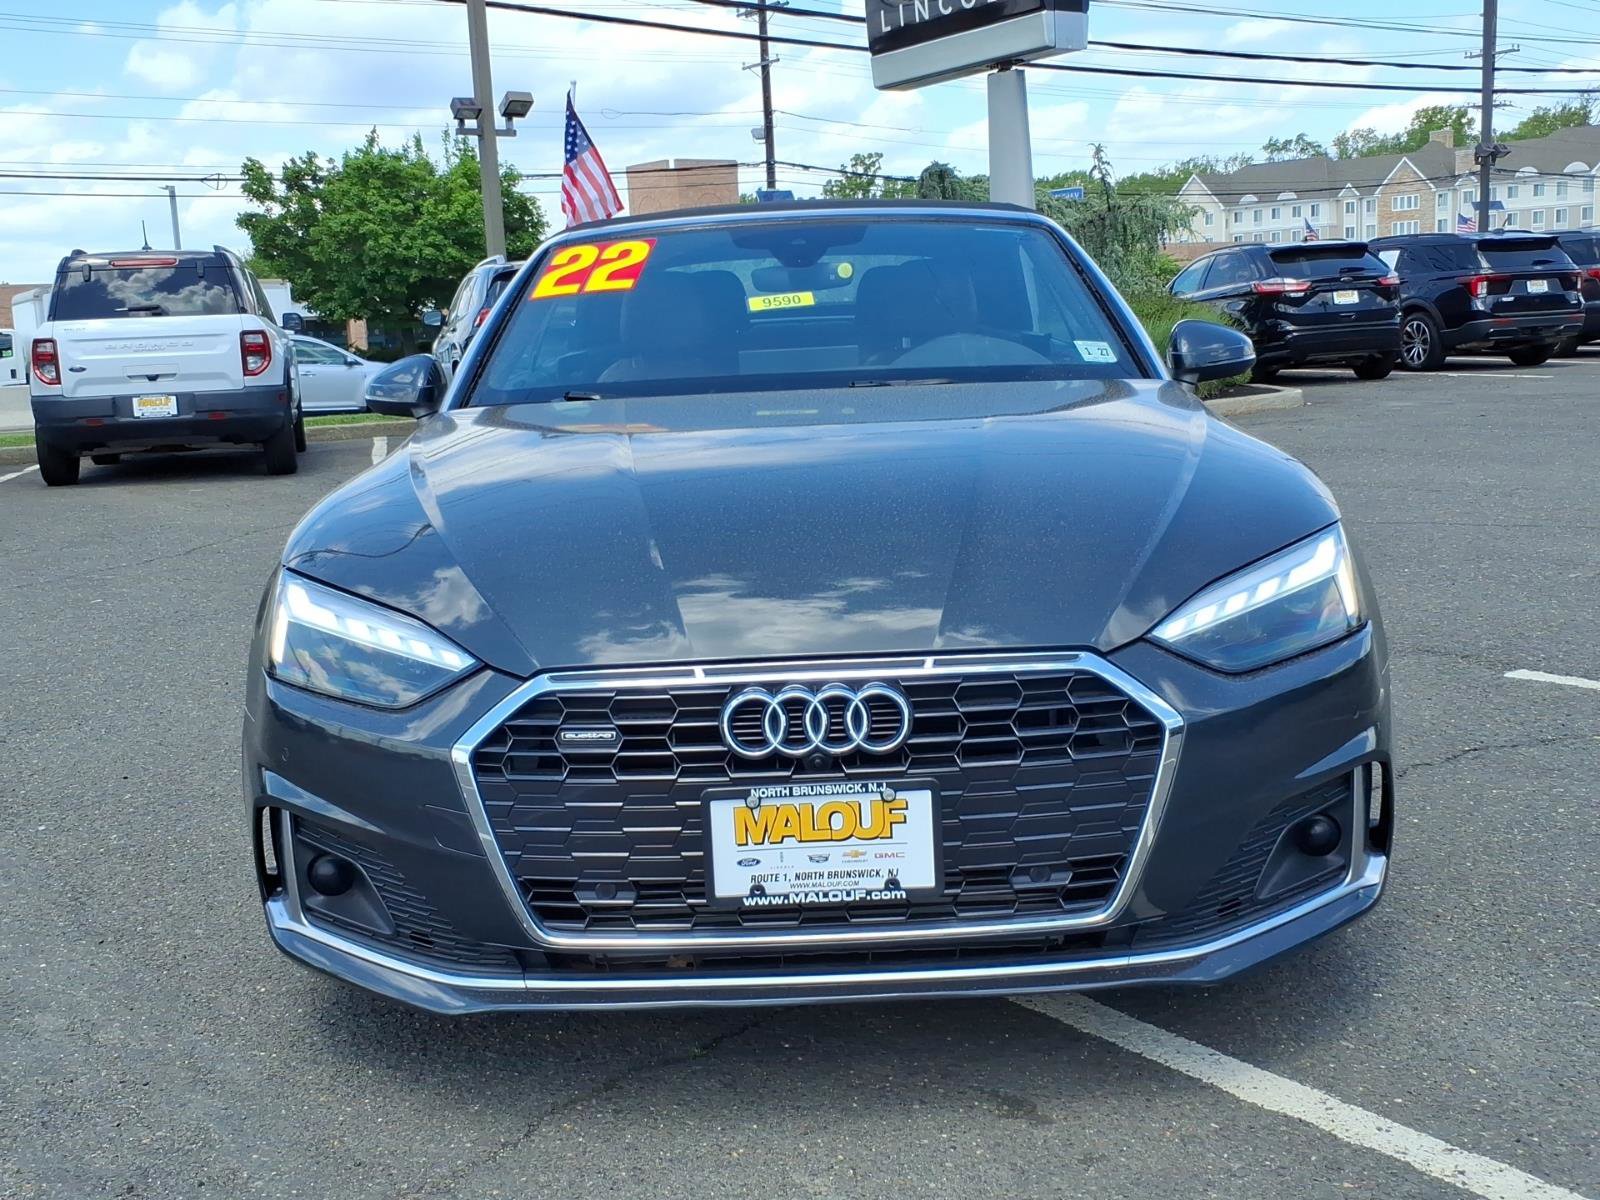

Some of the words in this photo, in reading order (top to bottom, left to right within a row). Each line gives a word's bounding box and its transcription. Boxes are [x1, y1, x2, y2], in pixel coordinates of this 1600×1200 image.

[531, 240, 651, 299] 22
[762, 295, 801, 307] 9590
[750, 787, 790, 798] NORTH
[733, 799, 908, 845] MALOUF
[751, 873, 780, 883] ROUTE
[783, 873, 792, 882] 1,
[794, 871, 825, 881] NORTH
[827, 868, 885, 879] BRUNSWICK,
[887, 868, 900, 877] NJ
[789, 880, 860, 889] WWW.MALOUF.COM
[742, 888, 907, 906] www.MALOUF.com
